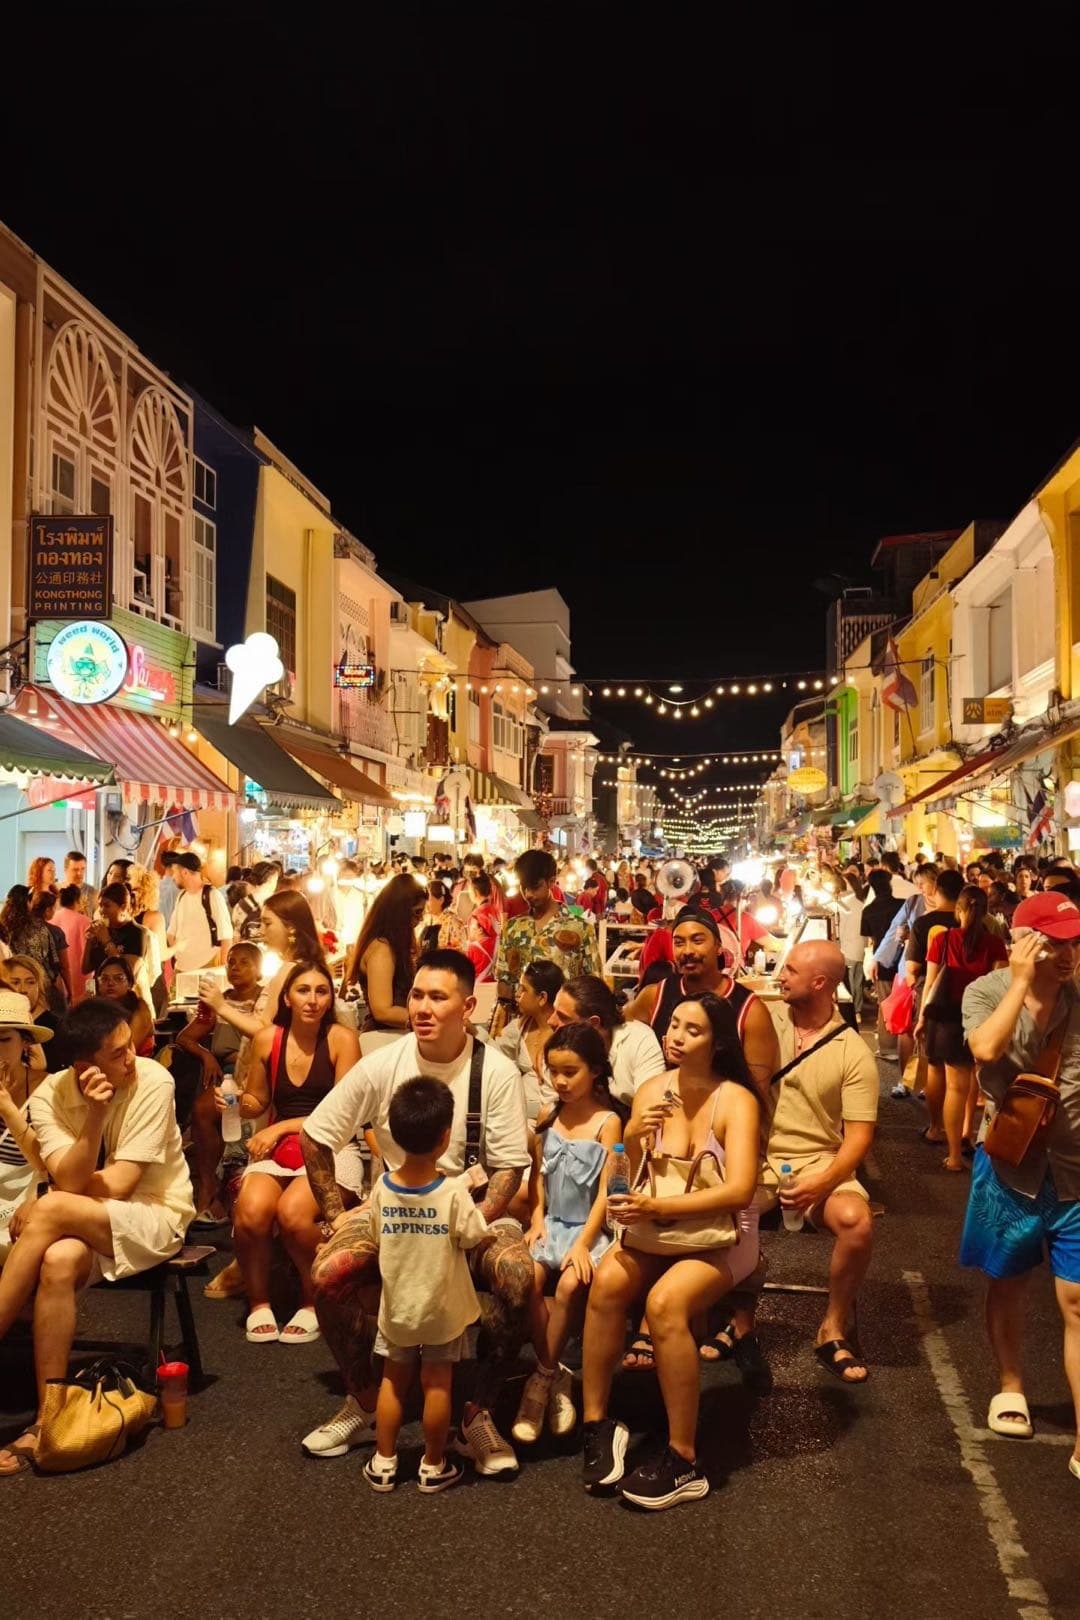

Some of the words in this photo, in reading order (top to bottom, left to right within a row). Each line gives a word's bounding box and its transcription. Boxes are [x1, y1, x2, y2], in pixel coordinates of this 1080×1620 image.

[36, 525, 104, 546] โรงพิมพ์
[36, 551, 103, 566] กองทอง
[35, 590, 103, 599] KONGTHONG
[34, 602, 103, 611] PRINTING
[58, 625, 88, 646] weed
[91, 626, 119, 654] world
[382, 1206, 437, 1219] SPREAD
[381, 1223, 449, 1235] APPINESS
